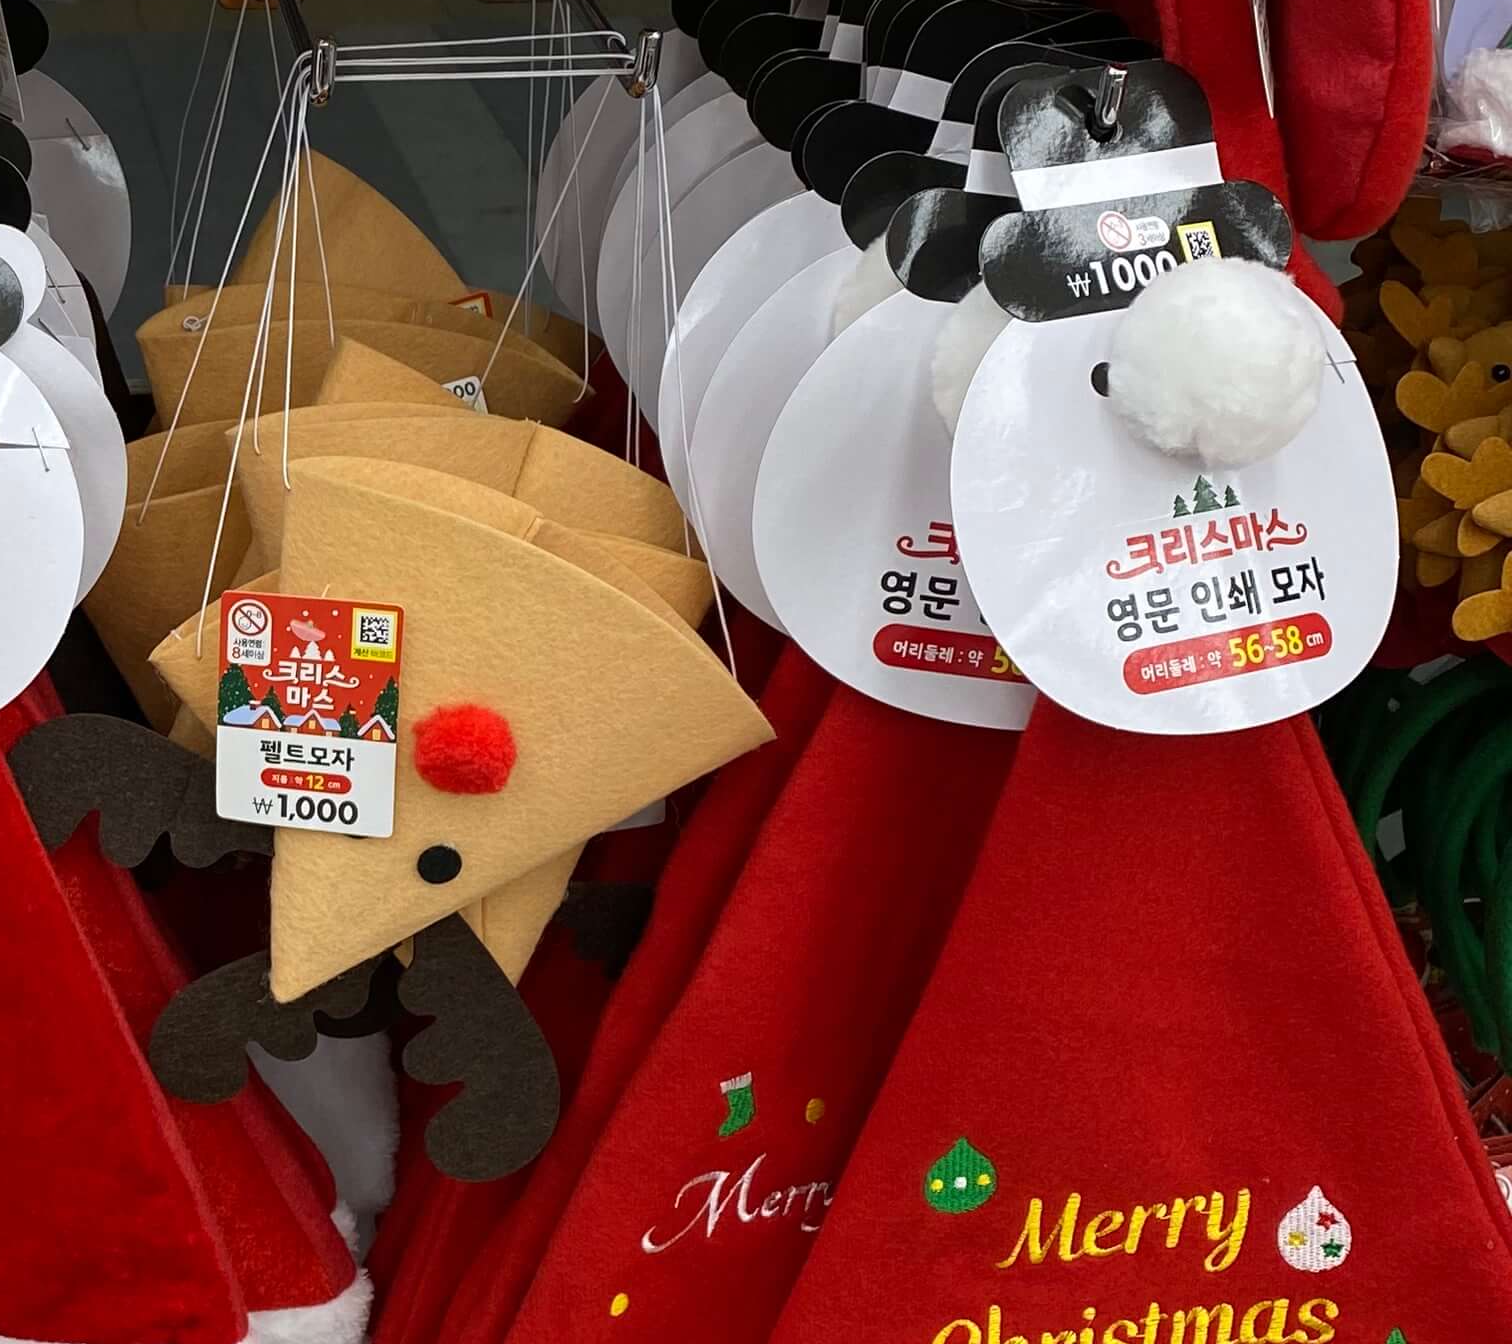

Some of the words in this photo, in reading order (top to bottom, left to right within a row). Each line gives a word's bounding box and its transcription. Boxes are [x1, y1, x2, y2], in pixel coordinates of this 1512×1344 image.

[1106, 508, 1308, 580] 크리스마스
[881, 570, 961, 621] 영문
[1107, 587, 1180, 643] 영문
[1191, 569, 1262, 624] 인쇄
[1271, 556, 1326, 604] 모자
[893, 640, 954, 664] 머리둘레
[968, 649, 985, 668] 약
[1141, 655, 1197, 682] 머리둘레
[1207, 650, 1222, 668] 약
[1228, 625, 1304, 668] 56~58
[1306, 632, 1325, 647] cm
[262, 660, 360, 689] 크리스
[286, 686, 335, 711] 마스
[260, 739, 355, 772] 펠트모자
[306, 774, 325, 790] 12
[328, 780, 341, 790] cm
[252, 793, 359, 825] ₩1,000
[995, 1186, 1252, 1273] Merry
